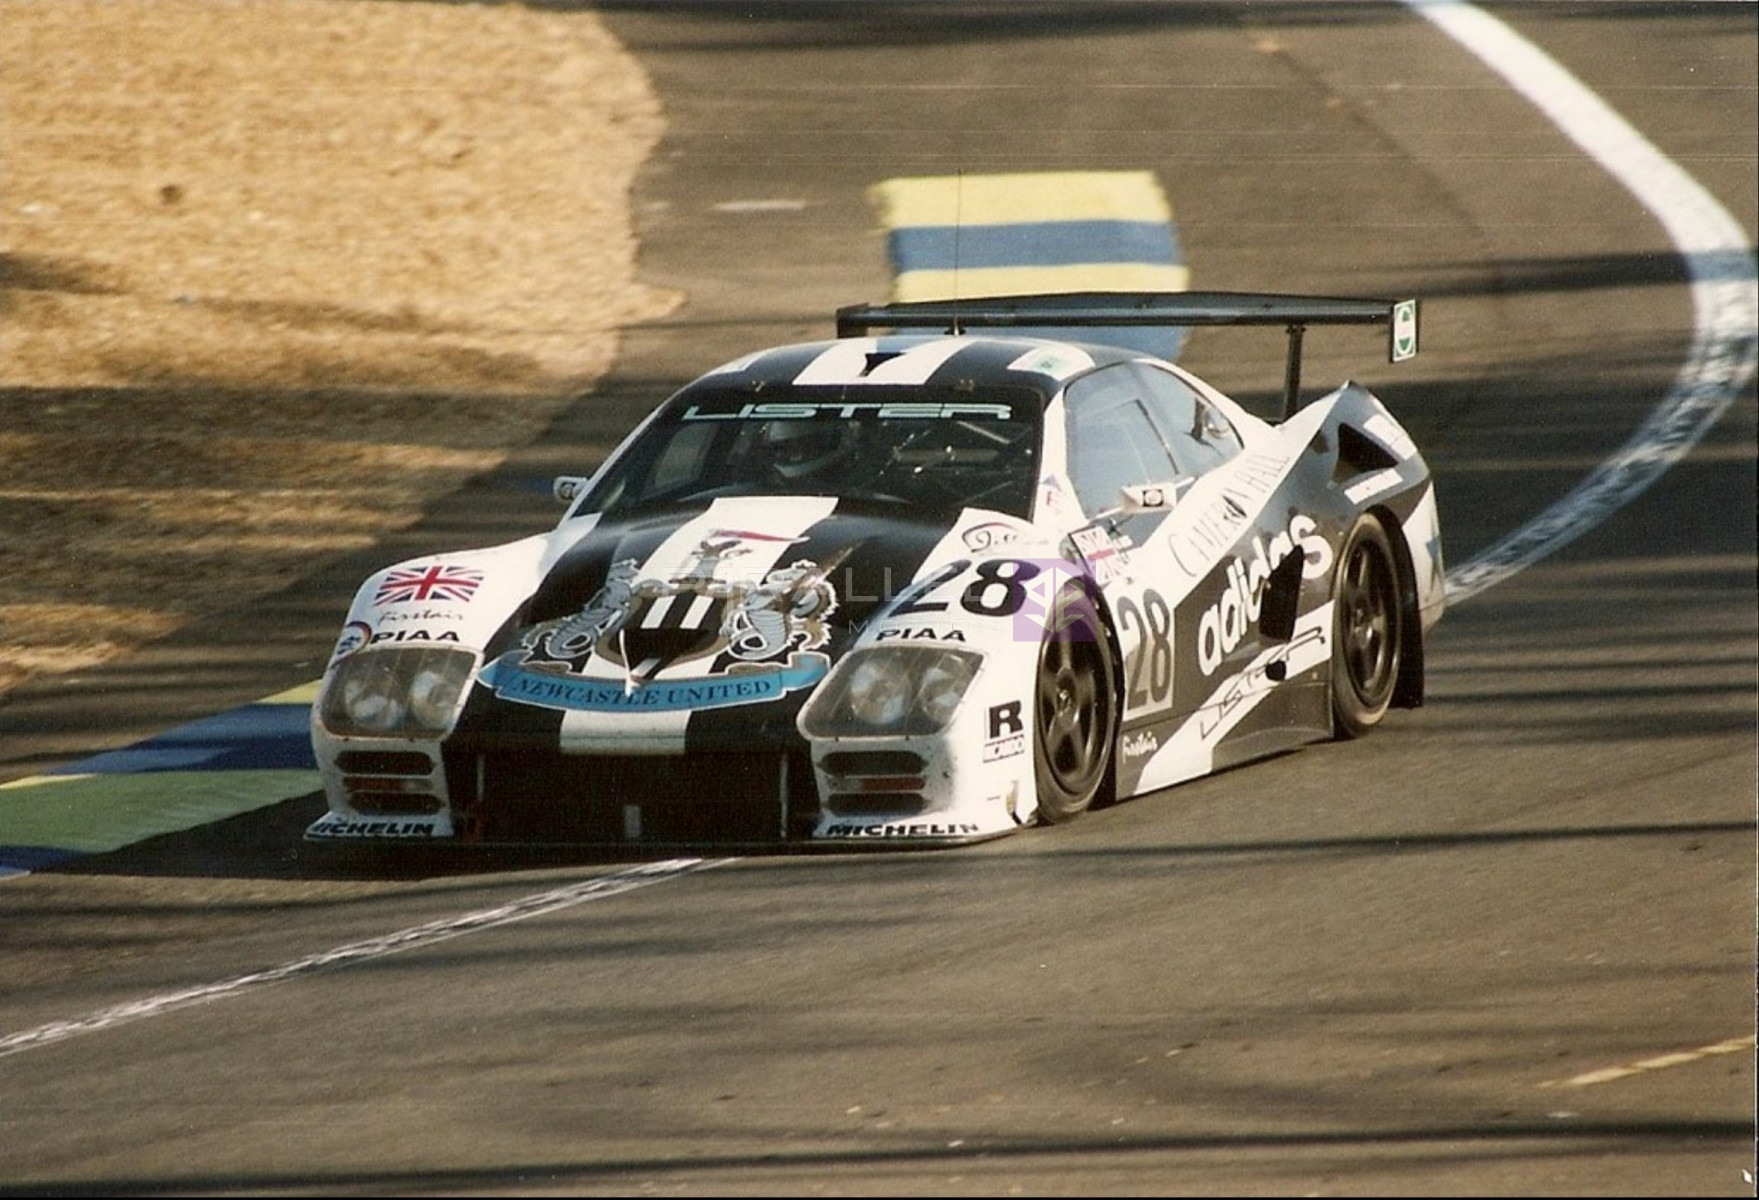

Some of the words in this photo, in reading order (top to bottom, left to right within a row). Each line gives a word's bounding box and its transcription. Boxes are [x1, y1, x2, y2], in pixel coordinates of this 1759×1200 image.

[682, 402, 1012, 421] LISTER
[1168, 487, 1252, 577] CAMERN
[886, 558, 1042, 617] 28
[369, 628, 461, 645] PIAA
[875, 627, 967, 642] PIAA
[1116, 587, 1172, 712] 28
[667, 680, 772, 703] UNITED
[988, 700, 1024, 739] R
[826, 823, 980, 836] MICHELIN
